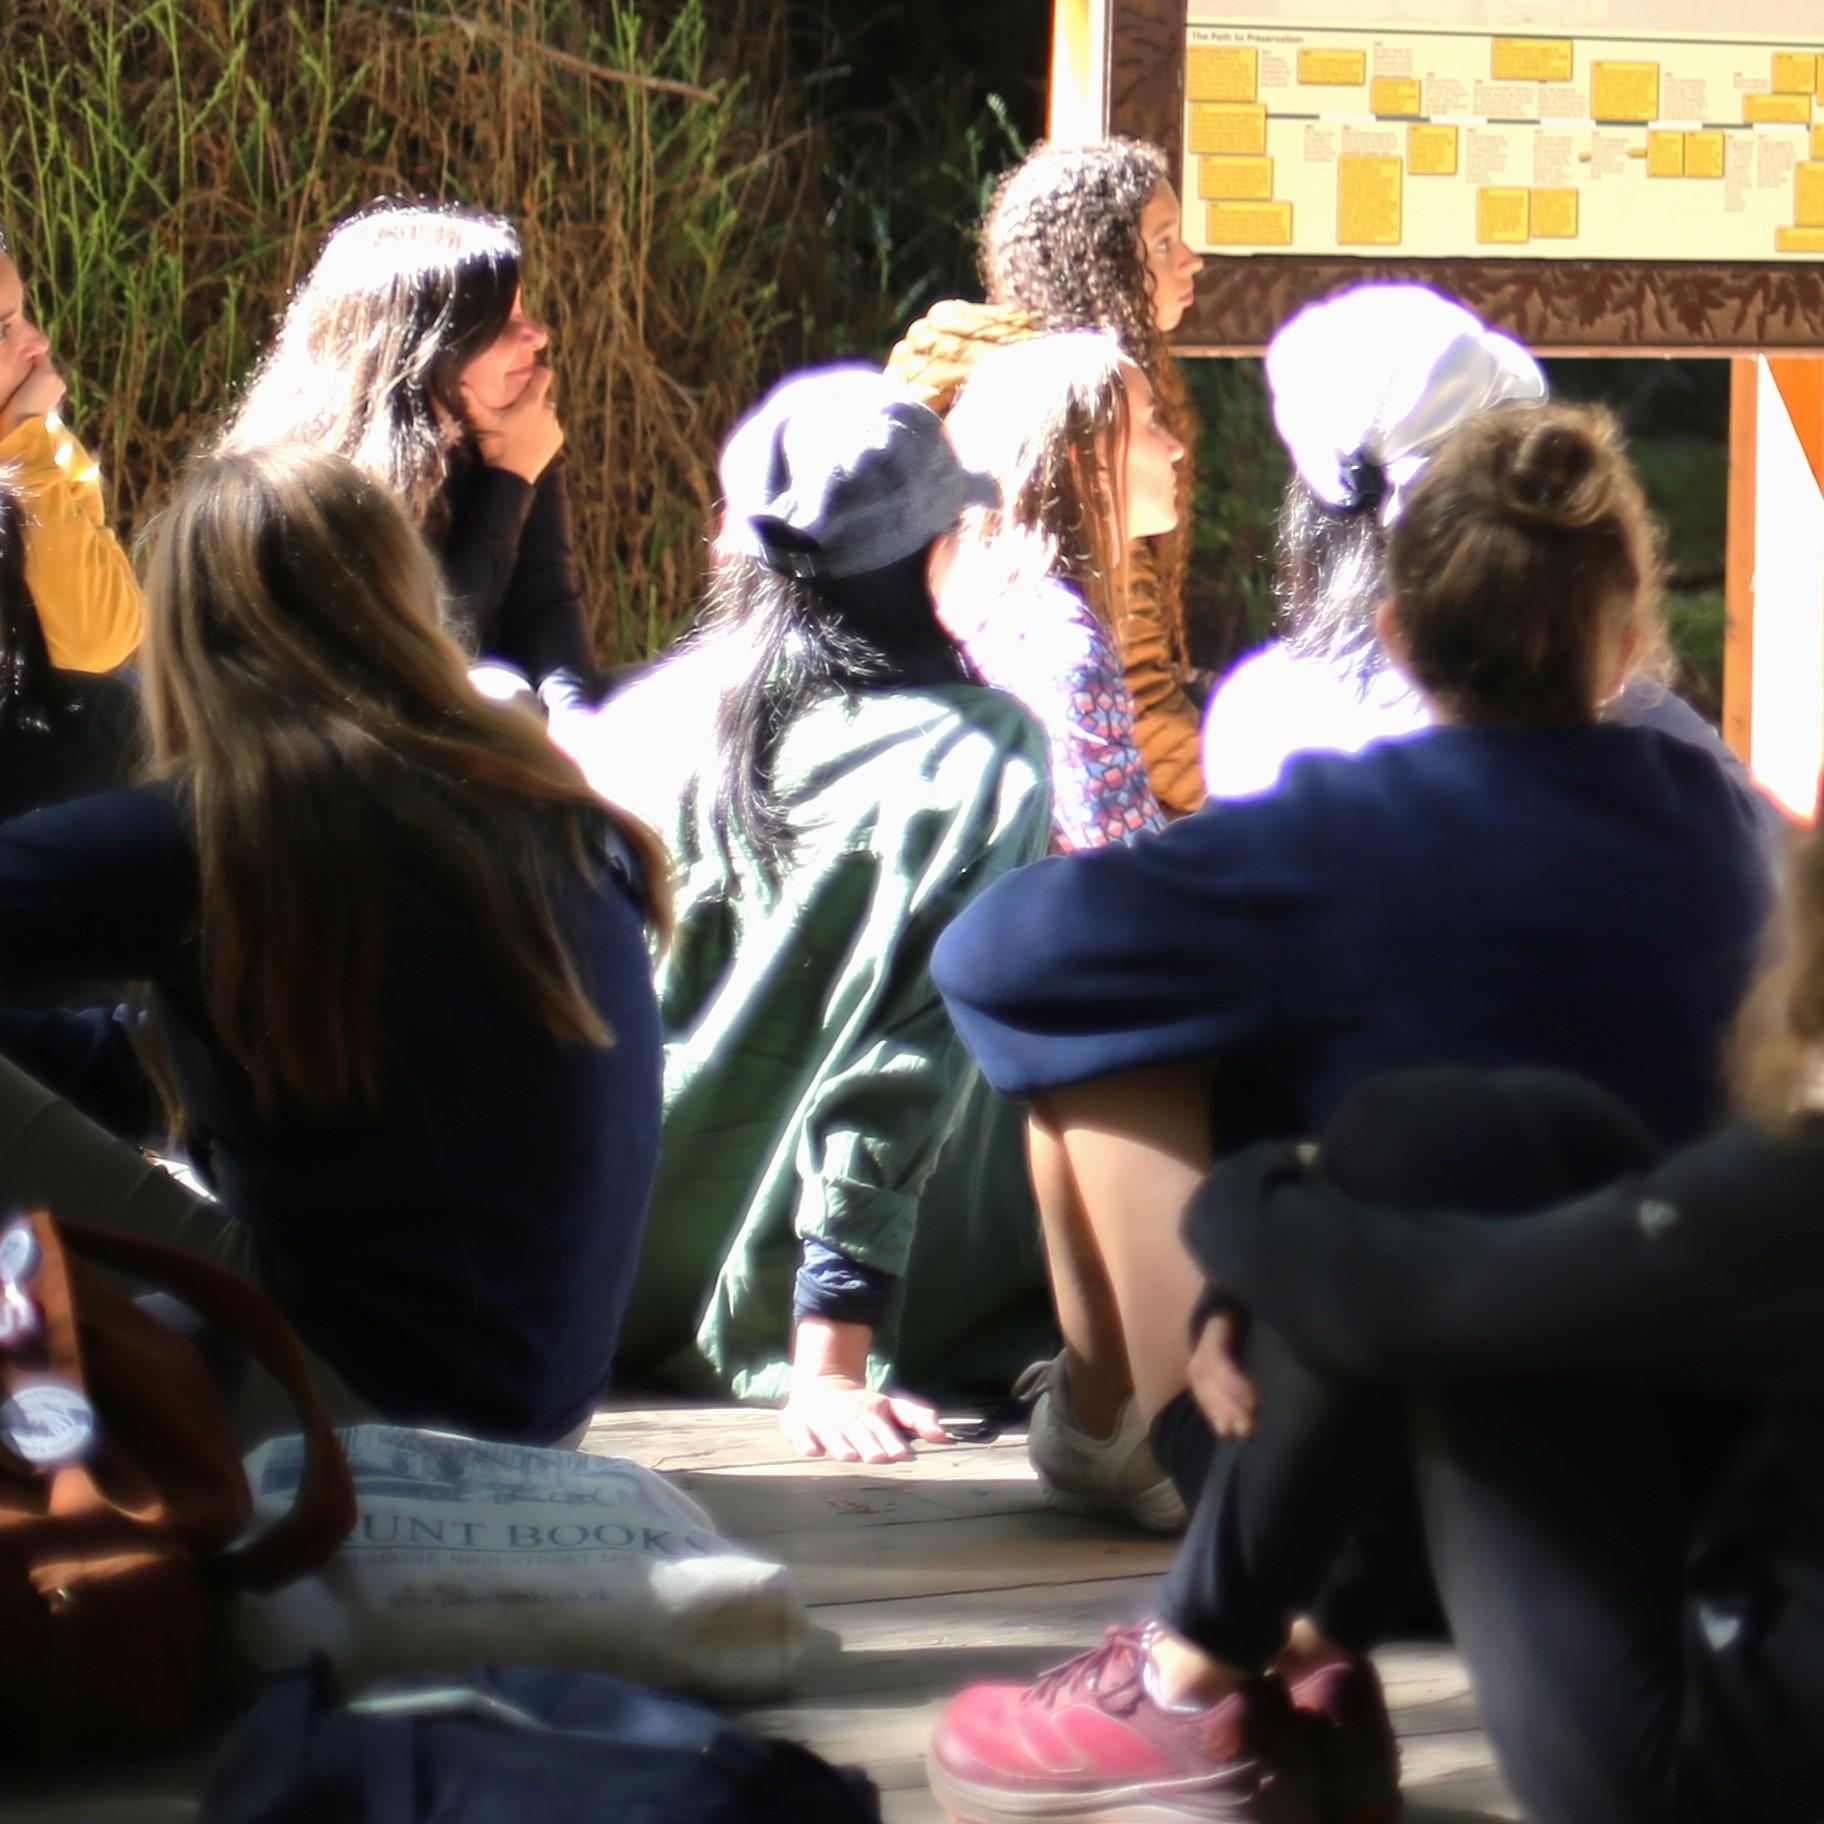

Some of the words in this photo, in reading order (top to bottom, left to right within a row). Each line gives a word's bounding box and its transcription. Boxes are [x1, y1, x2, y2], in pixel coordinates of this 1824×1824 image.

[1192, 31, 1208, 40] The
[1211, 32, 1231, 41] Path
[1234, 33, 1244, 41] to
[1247, 33, 1303, 44] Preservation
[344, 1513, 487, 1547] UNT
